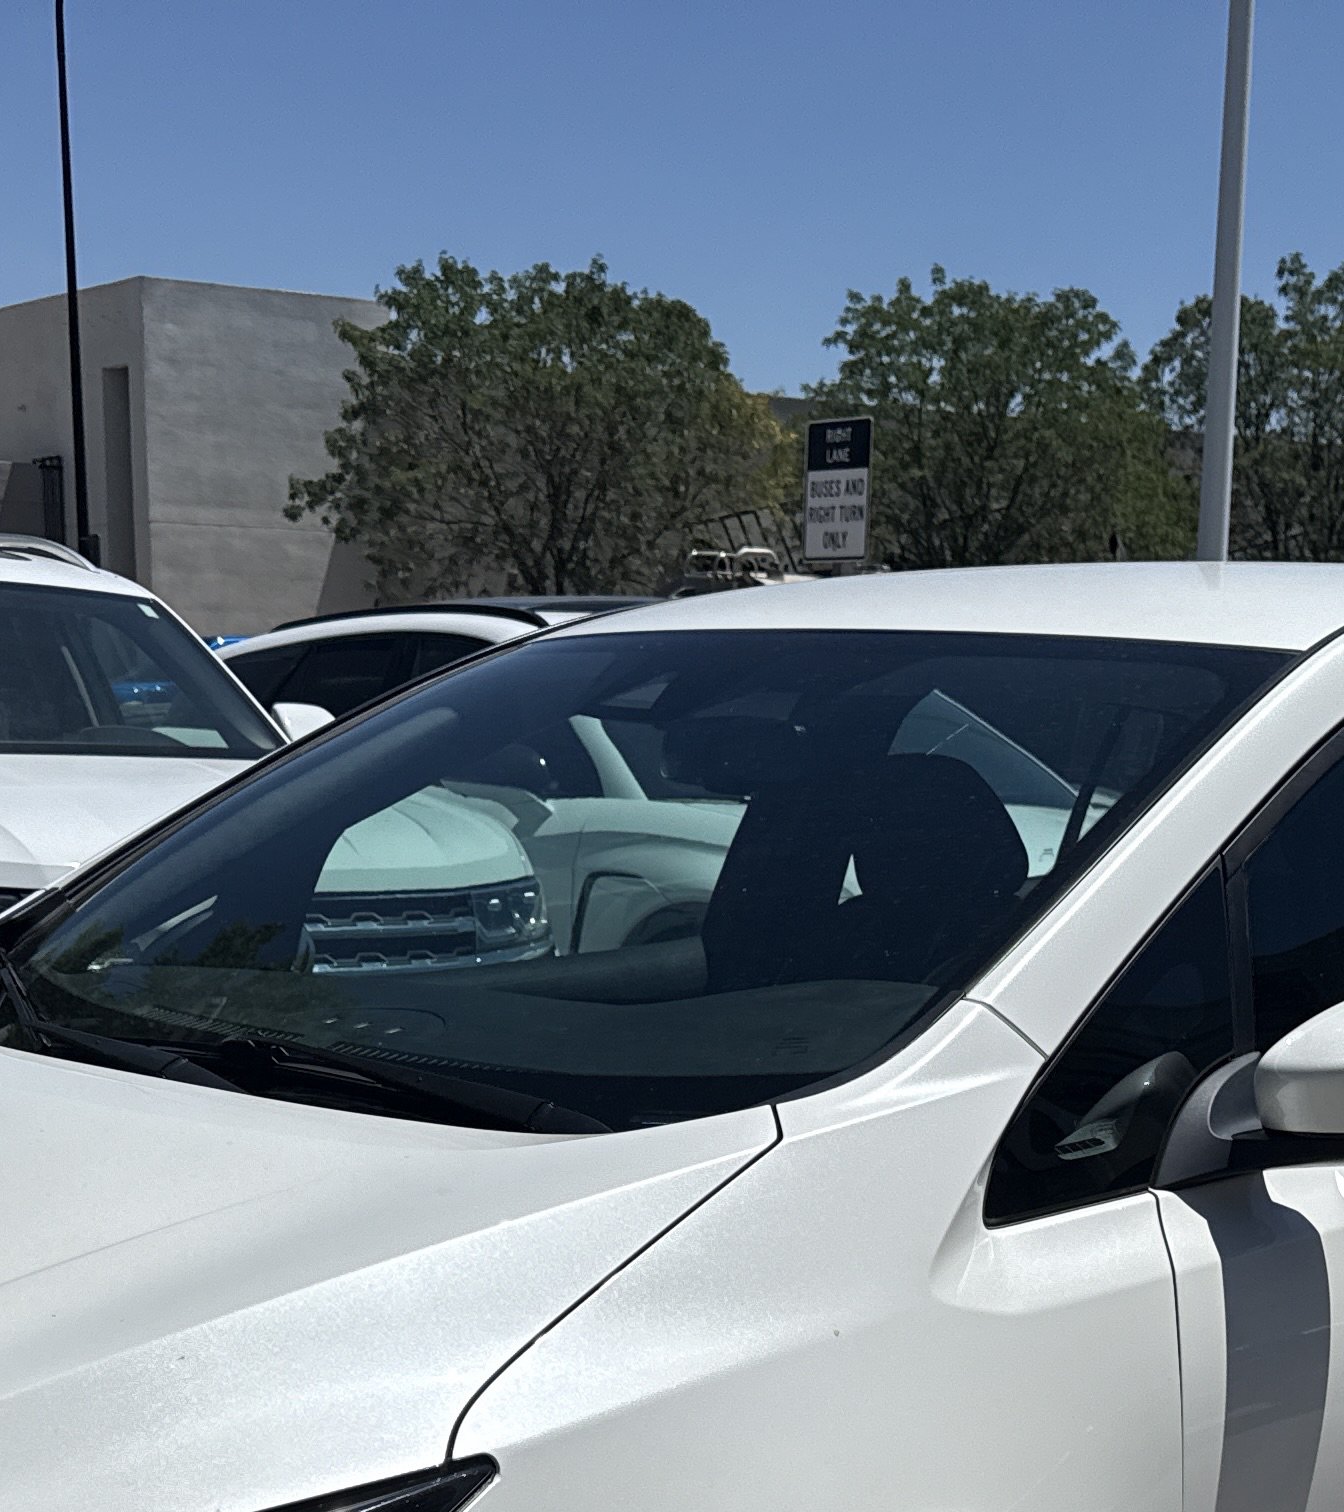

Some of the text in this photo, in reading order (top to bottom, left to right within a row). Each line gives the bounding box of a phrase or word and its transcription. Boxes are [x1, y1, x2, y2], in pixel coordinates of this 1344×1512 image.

[825, 448, 851, 463] LANE
[809, 478, 866, 499] BUSES AND
[822, 531, 849, 550] ONLY
